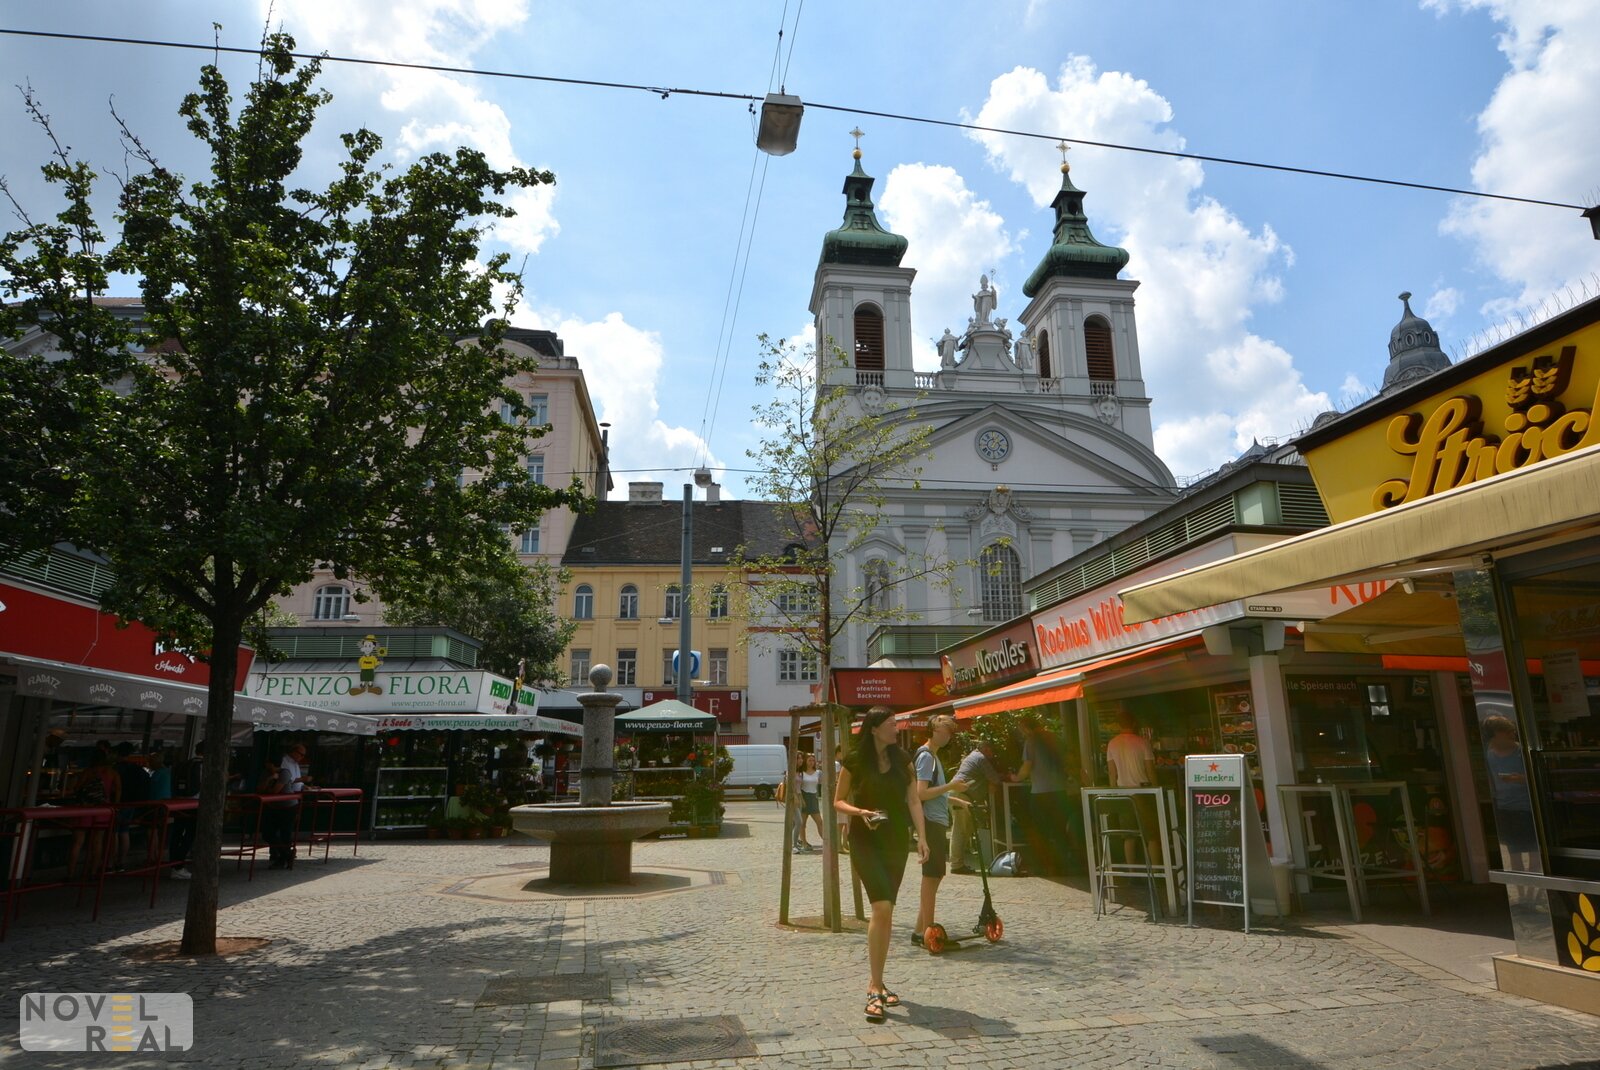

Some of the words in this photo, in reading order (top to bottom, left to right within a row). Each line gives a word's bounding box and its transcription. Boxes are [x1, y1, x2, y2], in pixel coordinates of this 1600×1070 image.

[1036, 619, 1091, 657] Rochus
[975, 637, 1027, 676] Noodles
[27, 673, 62, 689] RADATZ
[265, 676, 352, 696] PENZO
[388, 675, 472, 695] FLORA
[1299, 680, 1335, 692] Speisen
[1335, 680, 1357, 690] auch
[89, 683, 116, 697] RADATZ
[489, 679, 512, 700] PENZO
[517, 688, 536, 707] FLORA
[140, 690, 164, 703] RADATZ
[183, 697, 203, 709] RADATZ
[391, 699, 466, 708] www.penzo-flora.at
[427, 718, 519, 728] www.penzo-flora.at
[624, 721, 703, 730] www.penzo-flora.at
[1194, 773, 1235, 782] Heineken
[1195, 794, 1231, 805] TOGO
